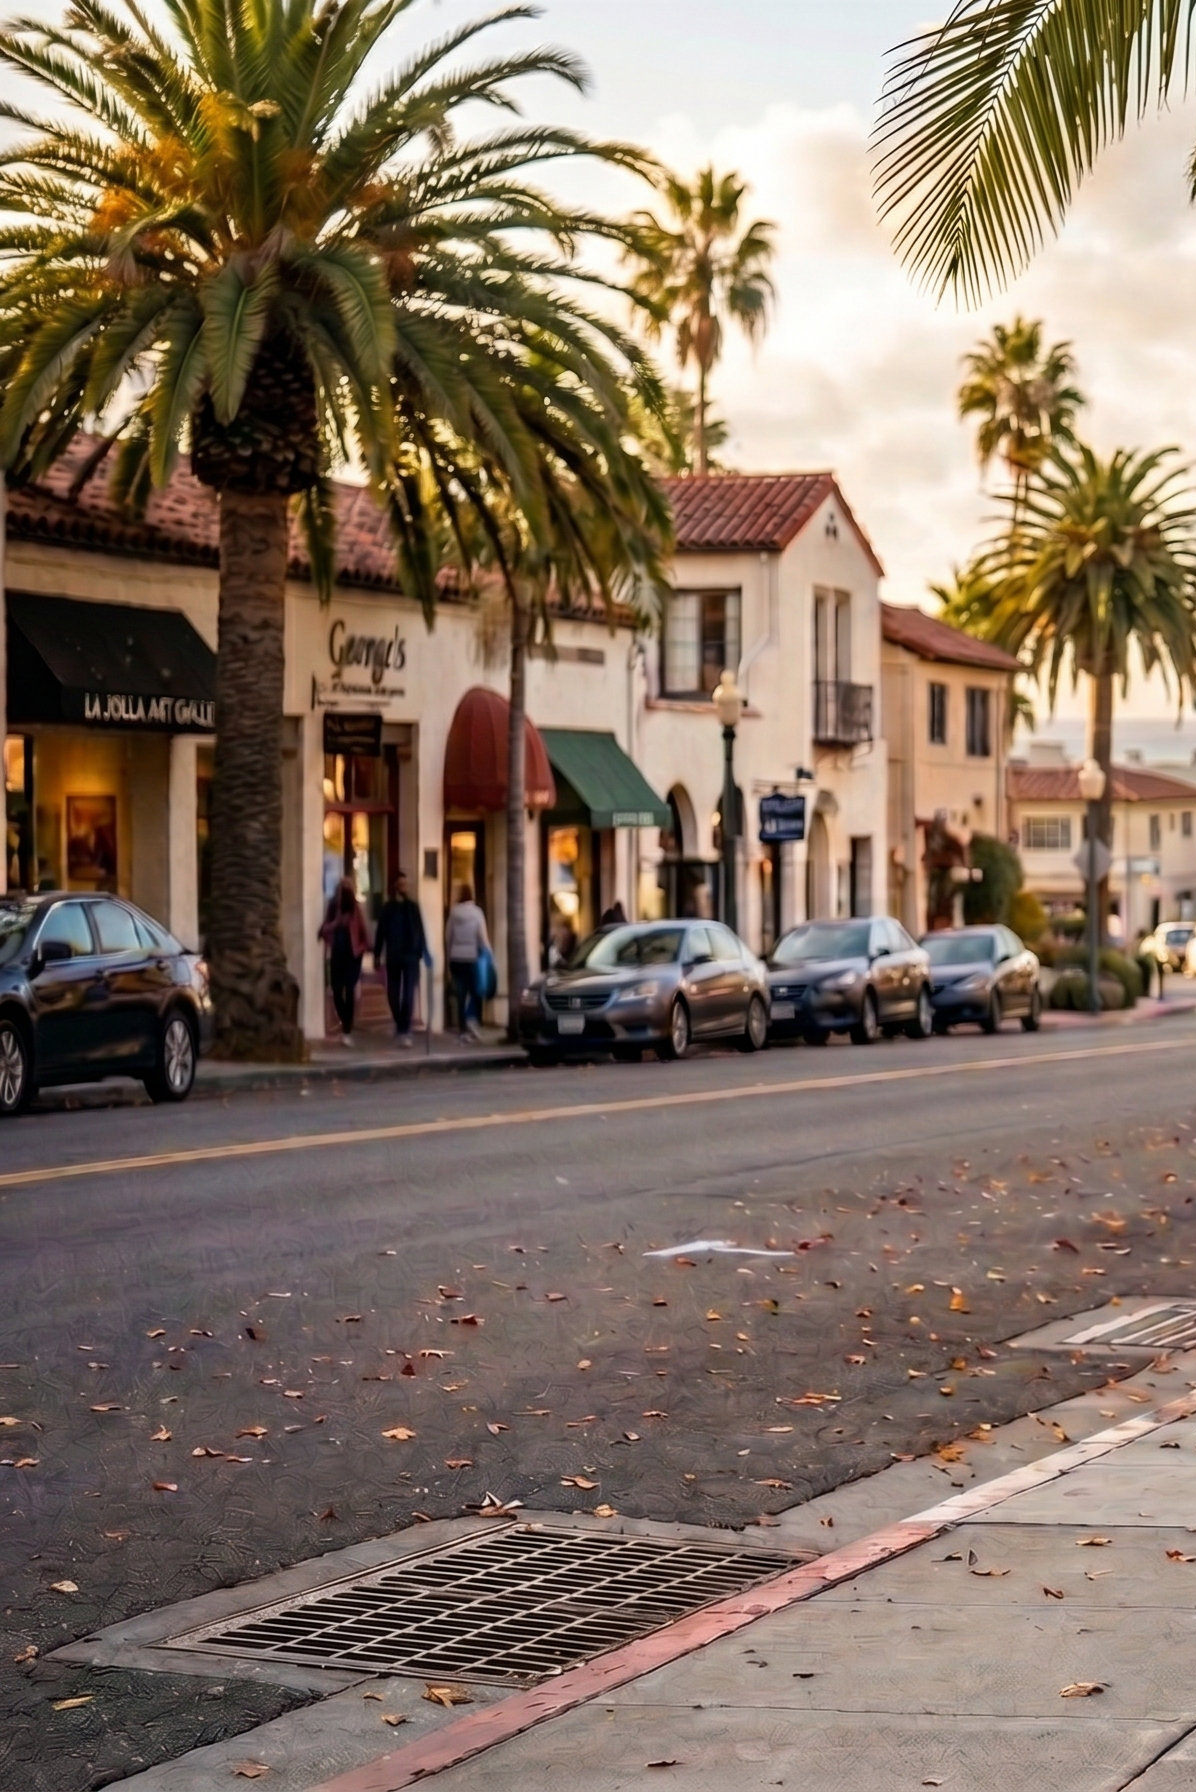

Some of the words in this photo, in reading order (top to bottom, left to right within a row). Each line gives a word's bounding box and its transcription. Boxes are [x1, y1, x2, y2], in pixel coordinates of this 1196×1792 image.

[329, 618, 406, 685] George's
[84, 692, 101, 720] LA
[103, 694, 146, 722] JOLLA
